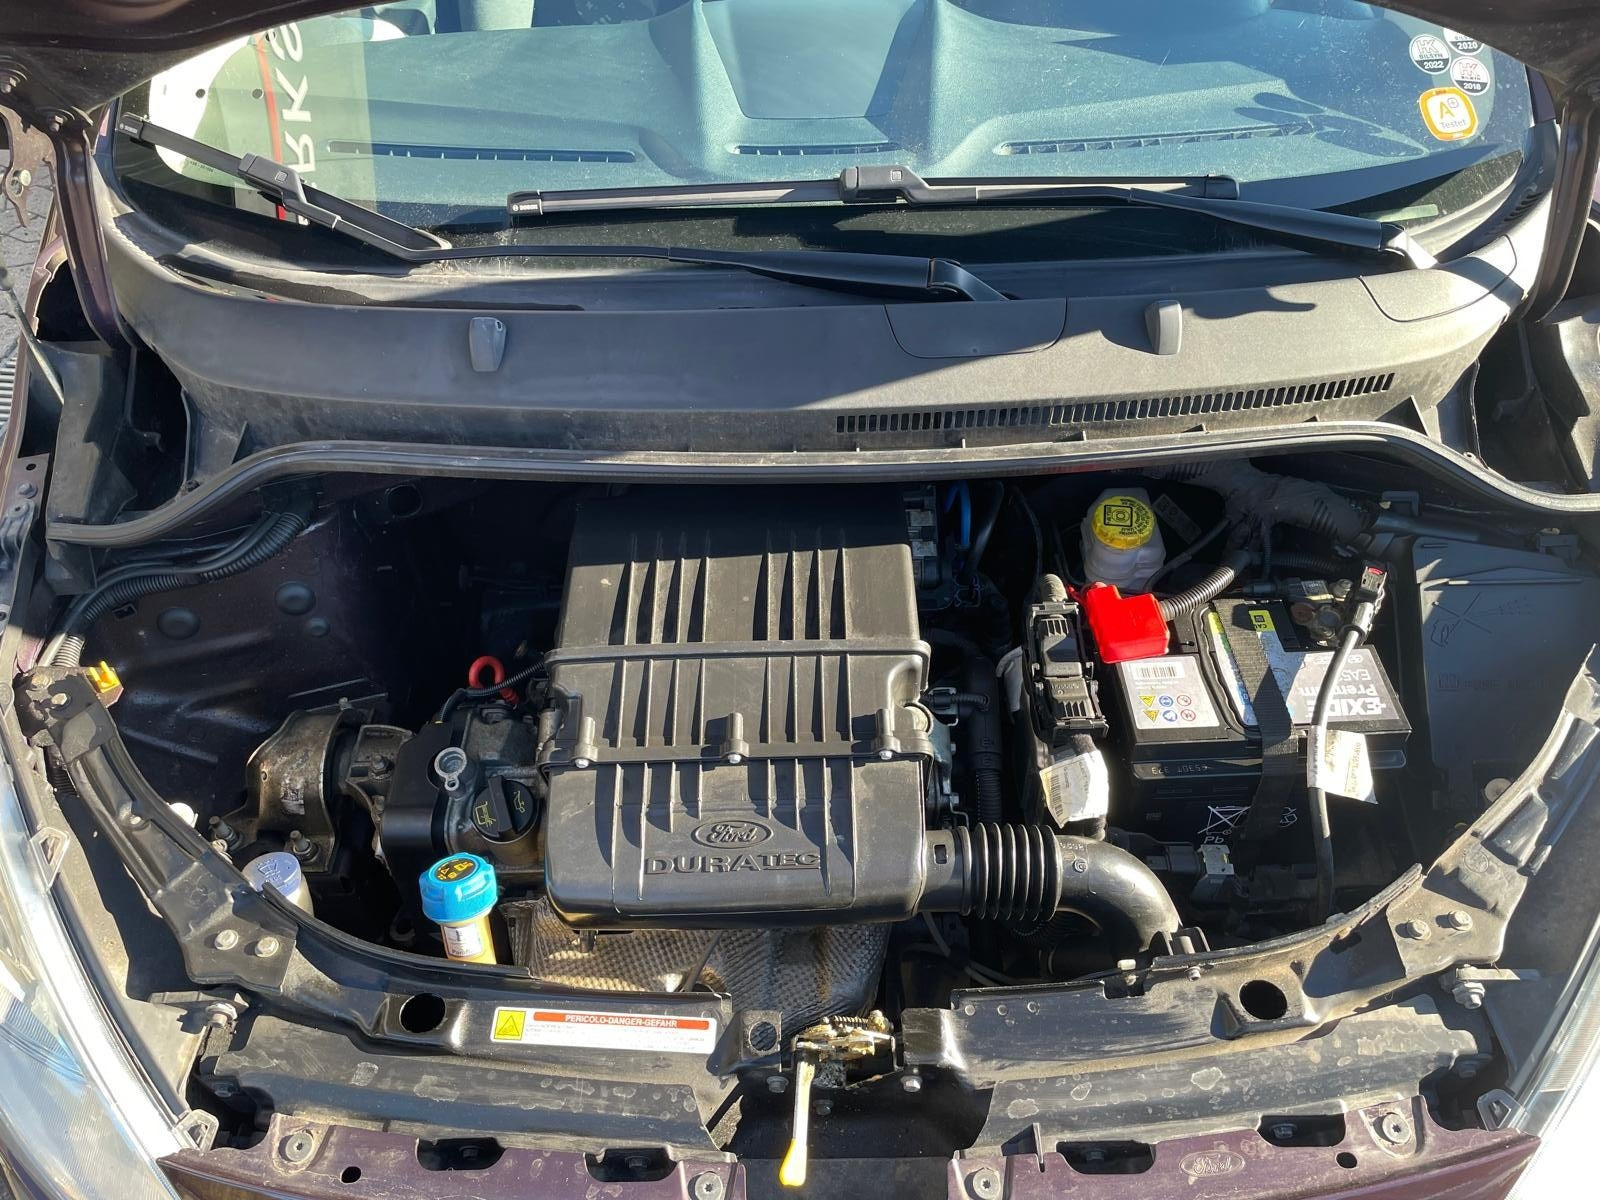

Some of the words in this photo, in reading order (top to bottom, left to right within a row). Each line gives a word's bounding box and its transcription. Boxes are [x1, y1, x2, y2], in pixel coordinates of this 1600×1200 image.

[1457, 41, 1478, 50] 2020
[1423, 61, 1445, 69] 2022
[1463, 82, 1482, 91] 2018
[706, 823, 758, 844] Ford
[1203, 836, 1225, 845] Pb
[645, 853, 821, 875] DURATEC
[564, 1013, 678, 1028] PERICOLO-DANGER-GEFAHR
